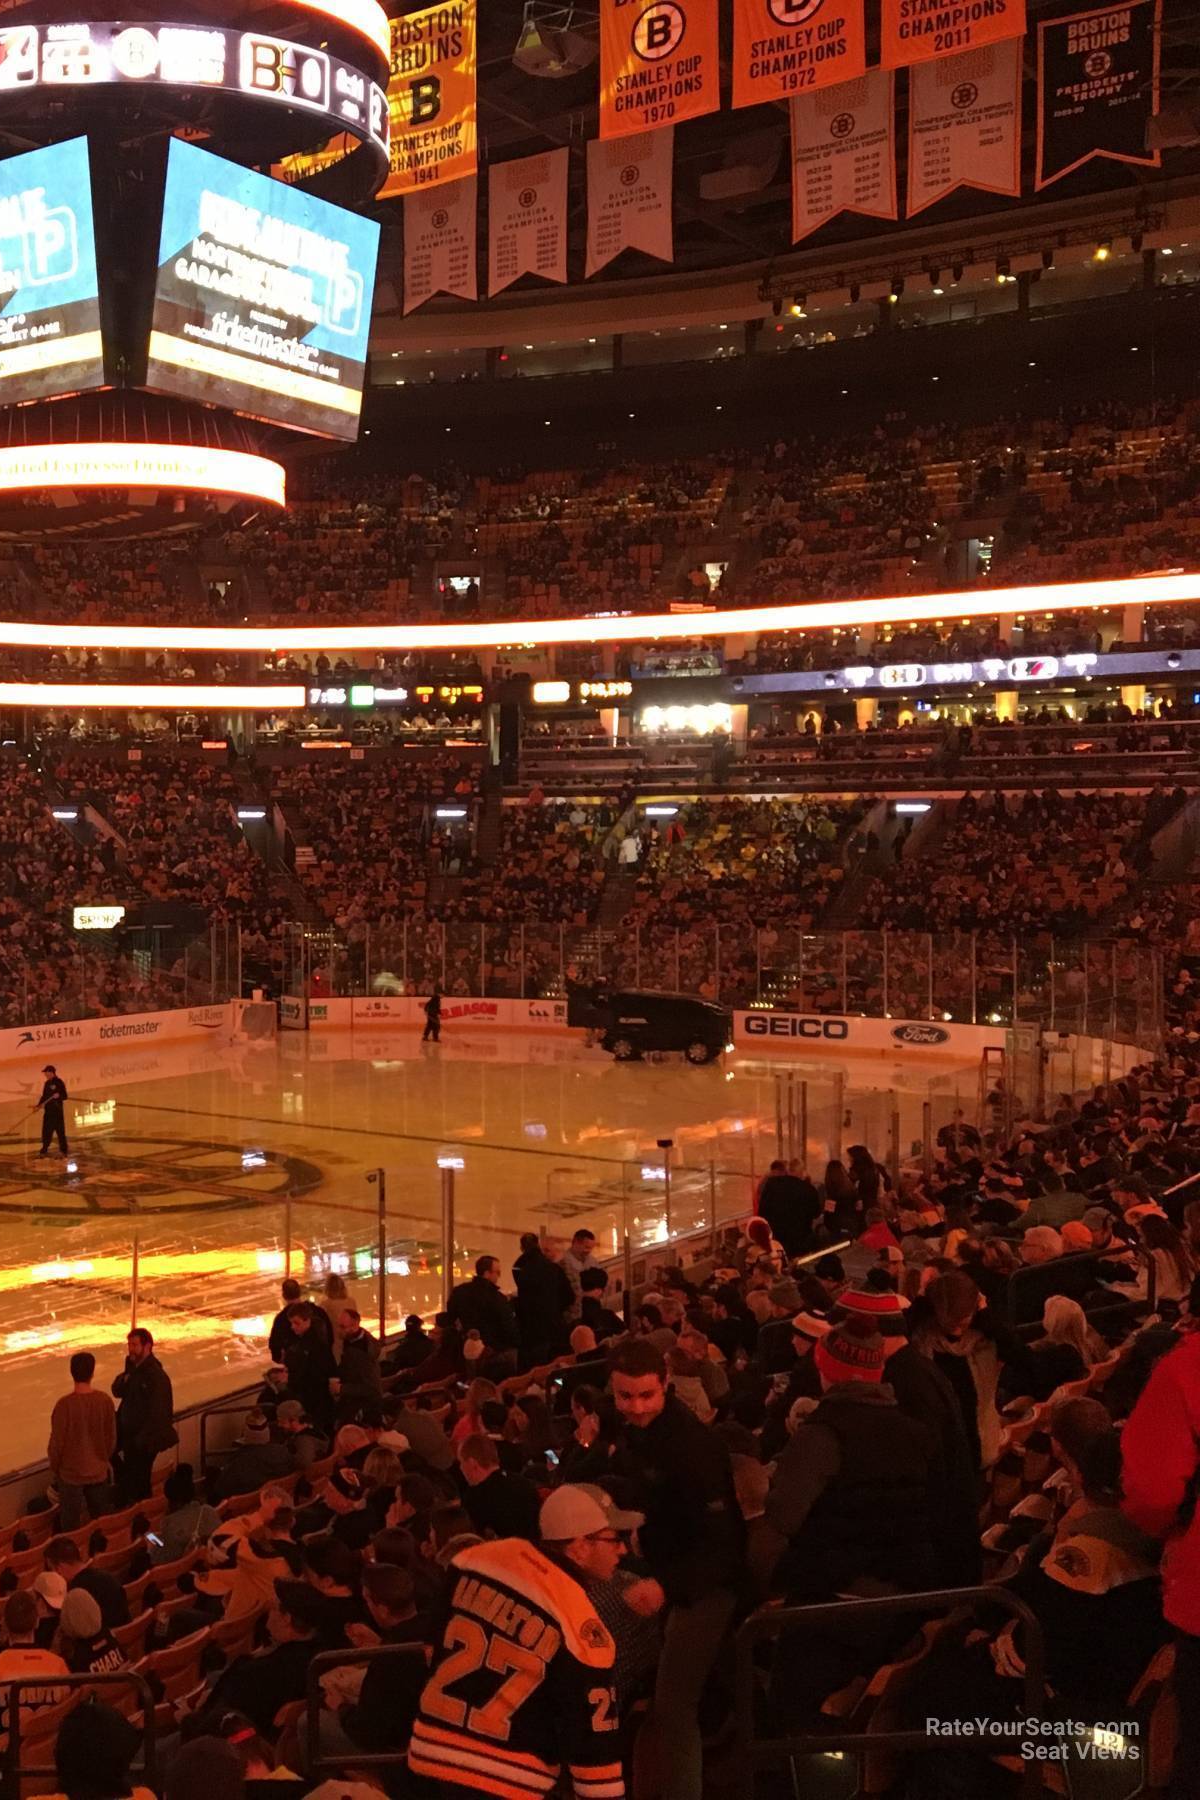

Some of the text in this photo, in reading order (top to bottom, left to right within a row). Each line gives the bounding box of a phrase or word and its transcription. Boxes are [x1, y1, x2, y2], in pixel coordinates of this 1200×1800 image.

[390, 5, 464, 46] BOSTON
[899, 1, 1007, 40] CHAMPIONS
[1068, 10, 1131, 39] BOSTON
[751, 18, 846, 59] STANLEY CUP
[934, 27, 971, 52] 2011
[1067, 27, 1130, 55] BRUINS
[390, 32, 463, 76] BRUINS
[749, 38, 847, 79] CHAMPIONS
[302, 57, 322, 98] 0
[616, 55, 703, 93] STANLEY CUP
[781, 67, 816, 91] 1972
[1056, 69, 1140, 97] PRESIDENTS'
[409, 75, 441, 126] B
[615, 74, 704, 112] CHAMPIONS
[1072, 84, 1122, 102] TROPHY
[643, 102, 675, 125] 1970
[915, 102, 1014, 126] CONFERENCE CHAMPIONS
[390, 122, 463, 155] STANLEY CUP
[389, 141, 464, 174] CHAMPIONS
[413, 166, 440, 185] 1941
[602, 192, 657, 210] CHAMPIONS
[609, 186, 650, 200] DIVISION
[502, 214, 554, 231] CHAMPIONS
[34, 218, 66, 274] P
[211, 311, 319, 363] ticketmaster
[36, 1026, 82, 1042] SYMETRA
[100, 1021, 161, 1040] ticketmaster
[744, 1014, 849, 1040] GEICO
[901, 1025, 939, 1044] Ford
[419, 1614, 546, 1741] 27
